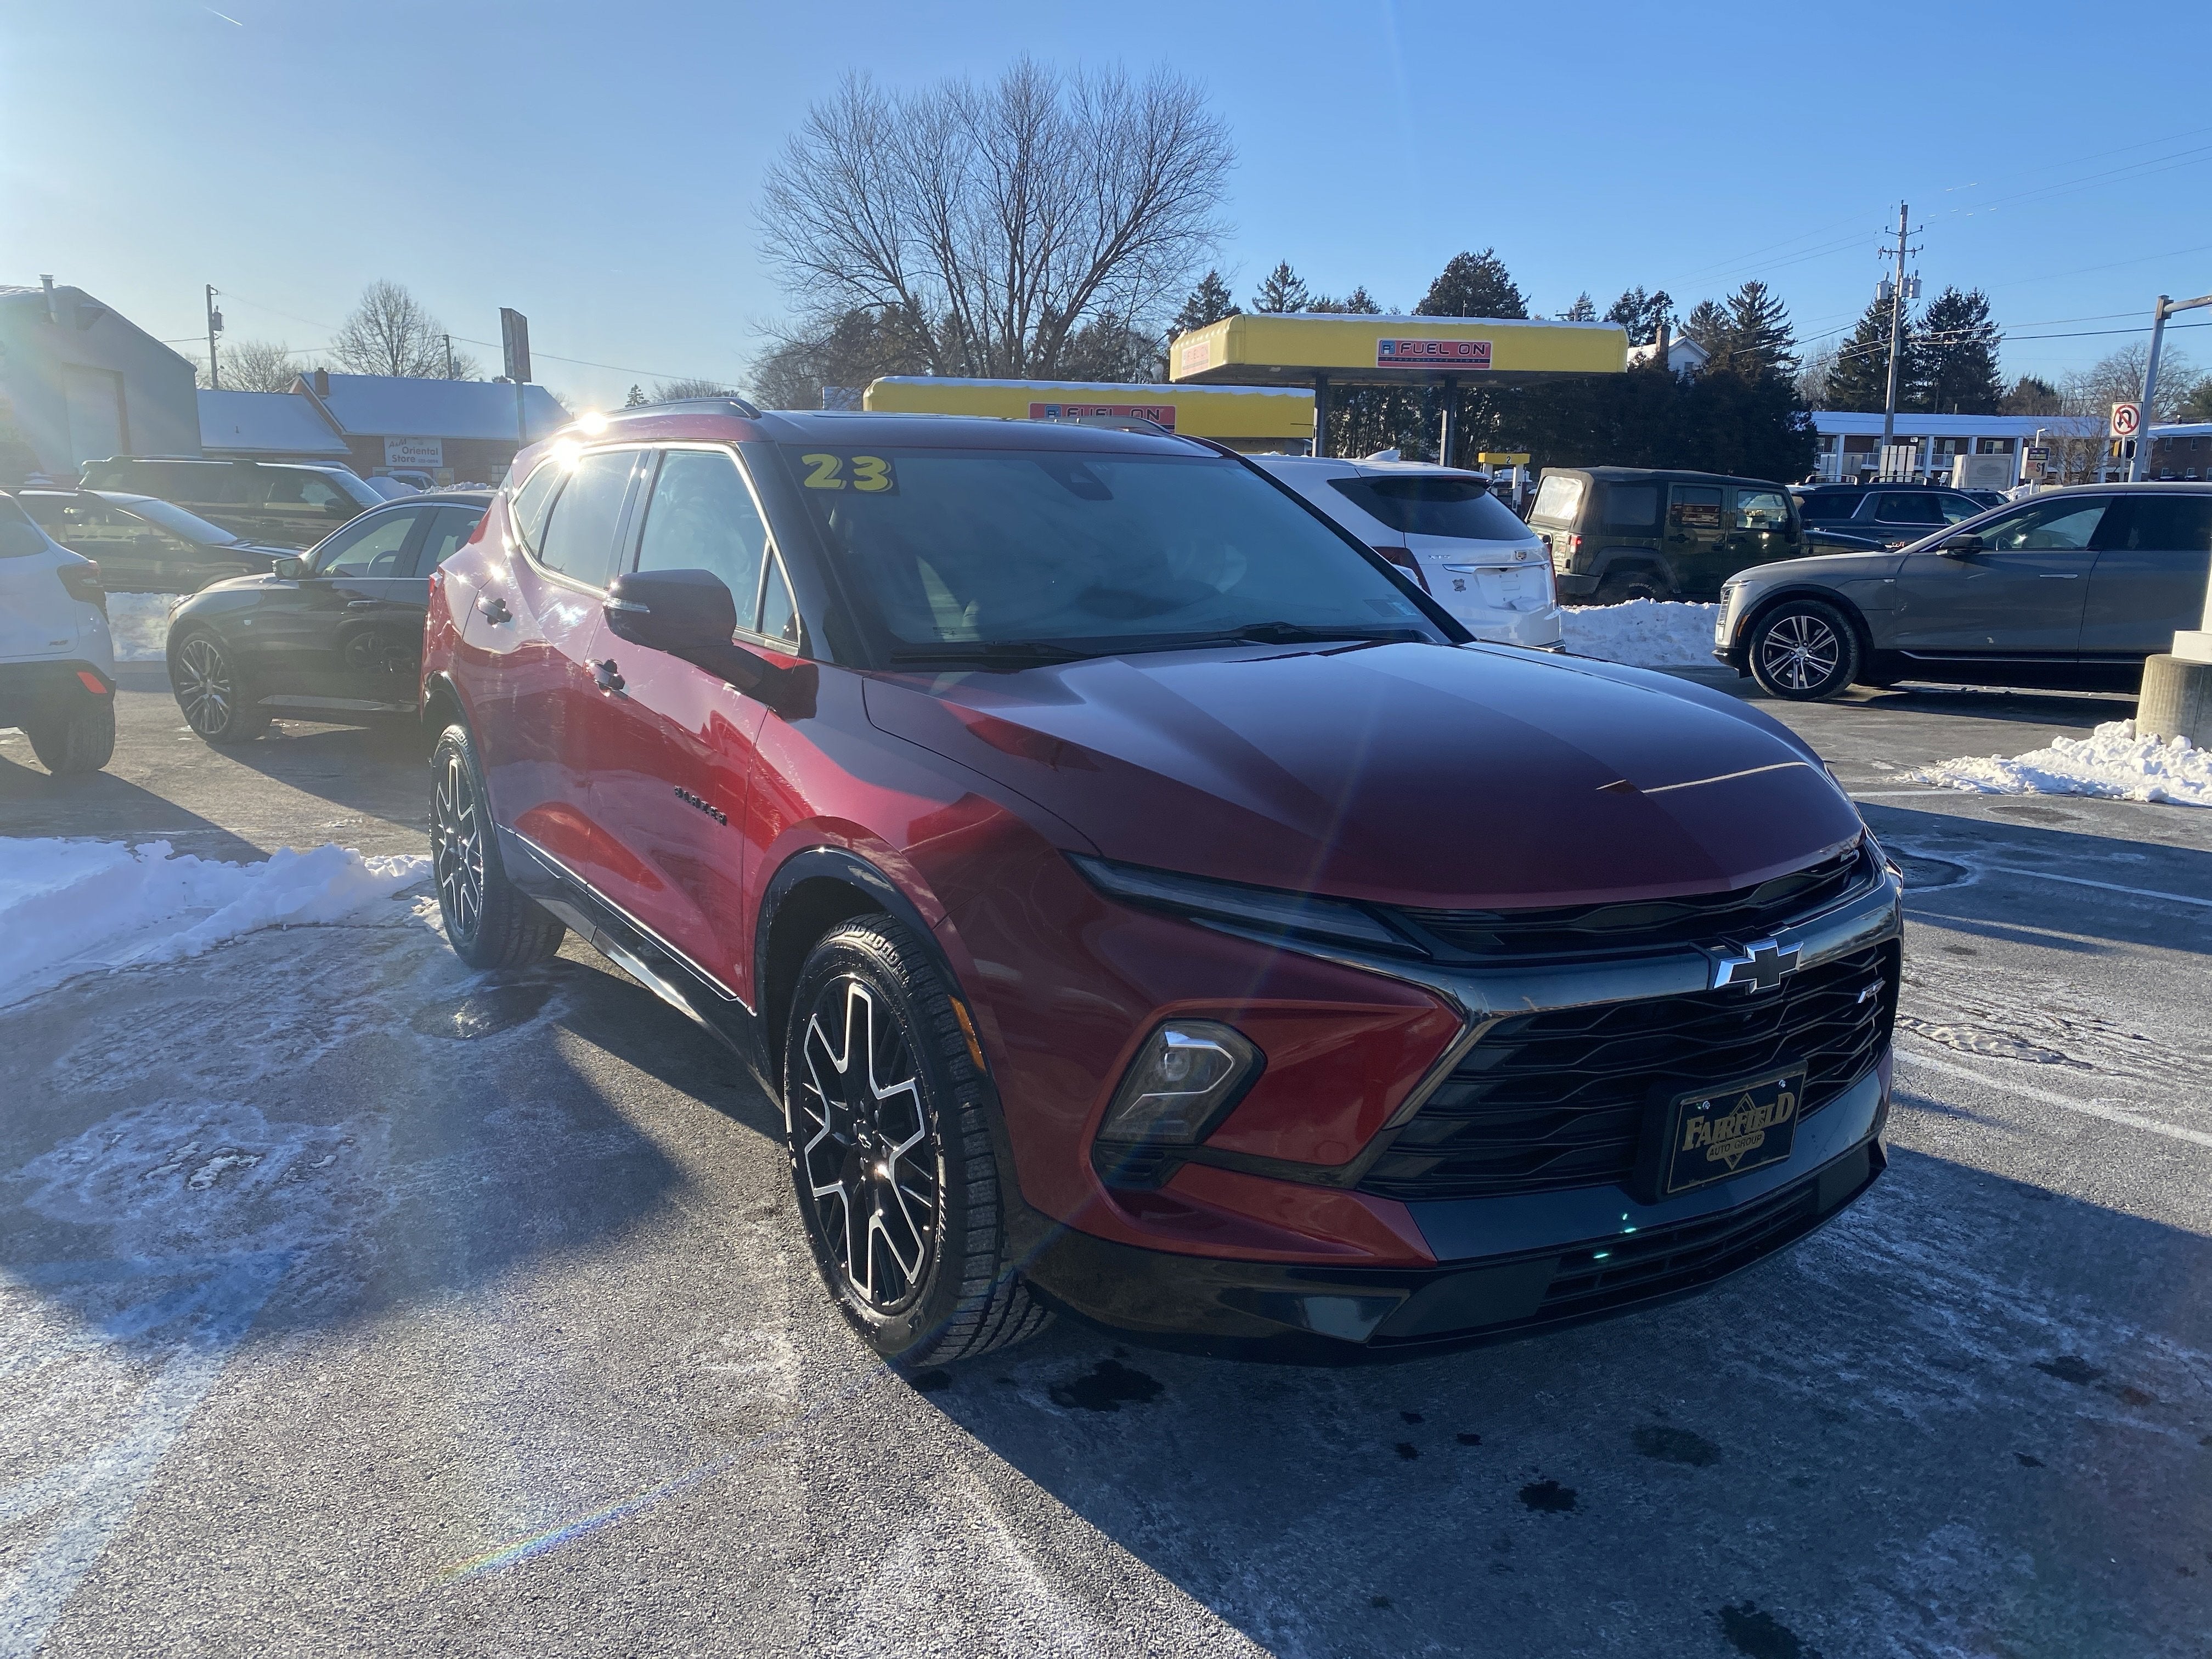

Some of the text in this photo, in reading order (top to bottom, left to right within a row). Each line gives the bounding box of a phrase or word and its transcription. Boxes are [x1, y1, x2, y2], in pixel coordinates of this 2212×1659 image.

[1400, 343, 1486, 356] FUEL ON
[402, 446, 438, 455] Oriental
[392, 454, 416, 462] Store
[1506, 456, 1511, 464] 2
[802, 453, 893, 493] 23
[1628, 582, 1657, 594] IRONMAN
[1682, 1092, 1795, 1152] FAIRFIELD
[1709, 1134, 1762, 1156] AUTO GROUP
